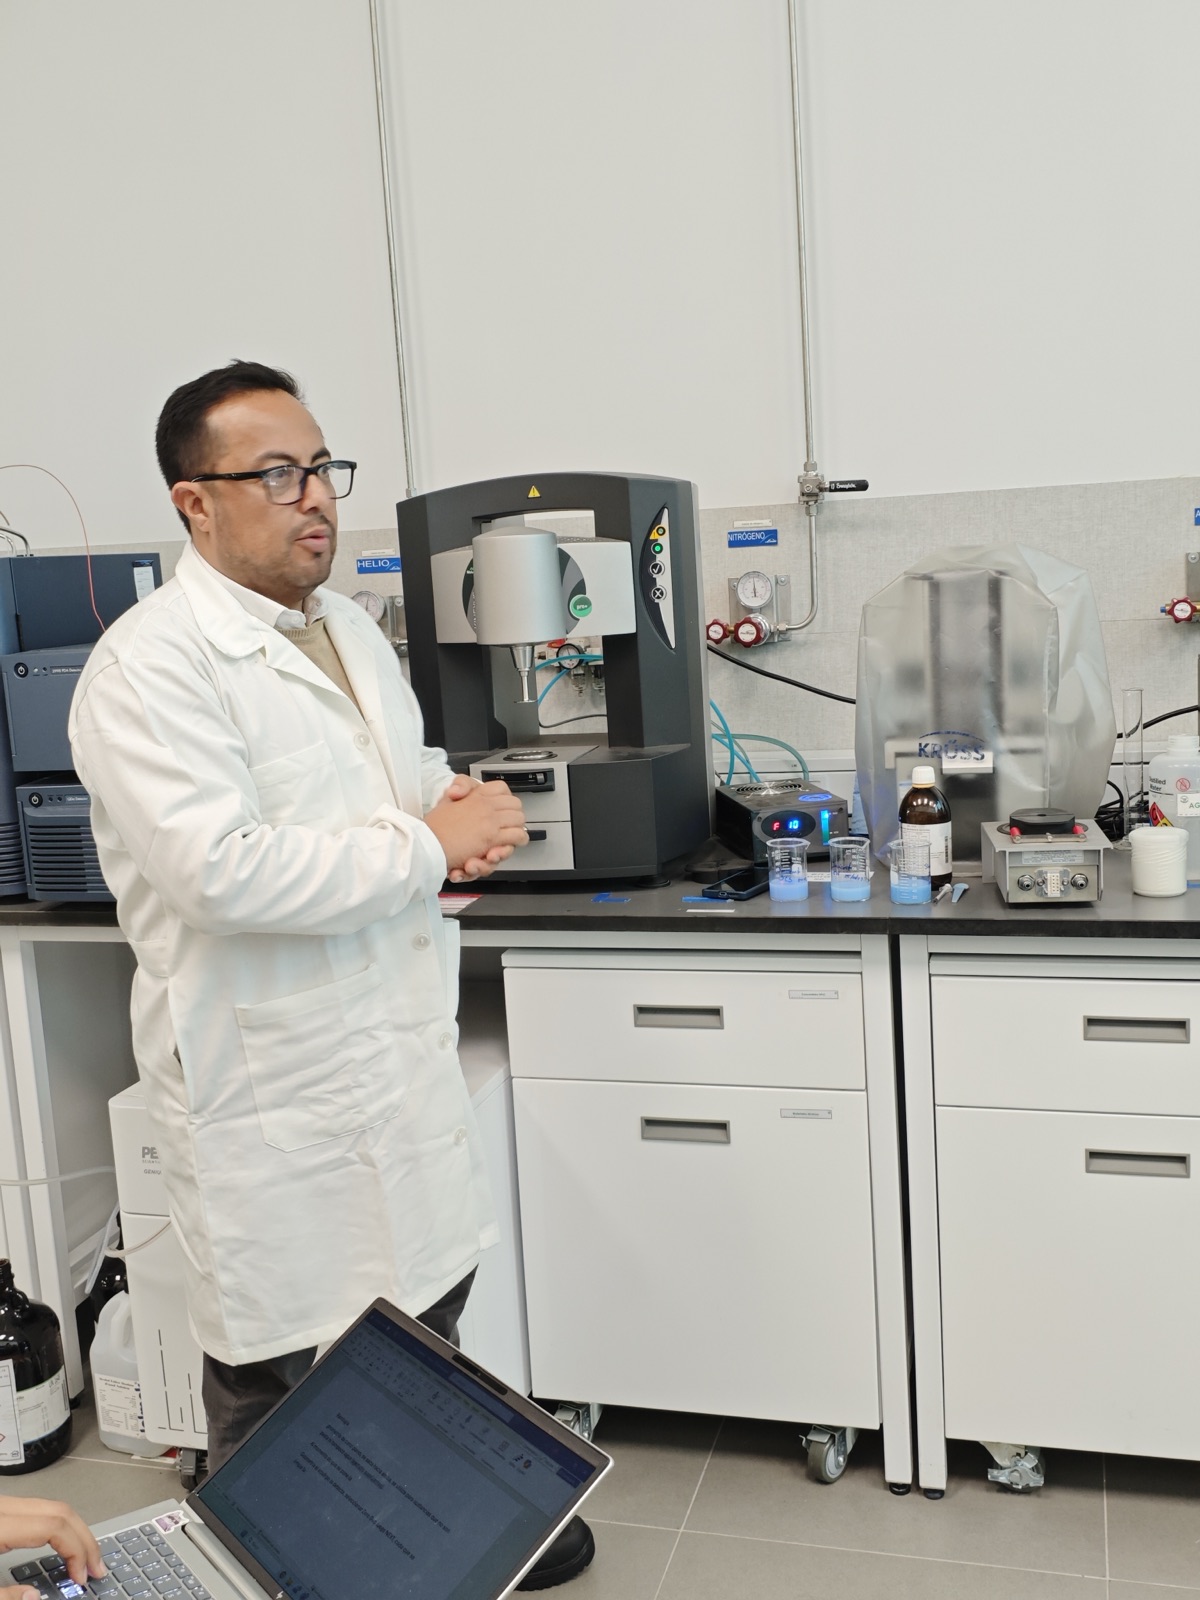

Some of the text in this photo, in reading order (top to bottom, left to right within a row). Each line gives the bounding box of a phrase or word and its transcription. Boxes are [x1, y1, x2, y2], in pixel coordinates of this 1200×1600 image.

[357, 559, 390, 568] HELIO
[773, 820, 799, 831] F 10
